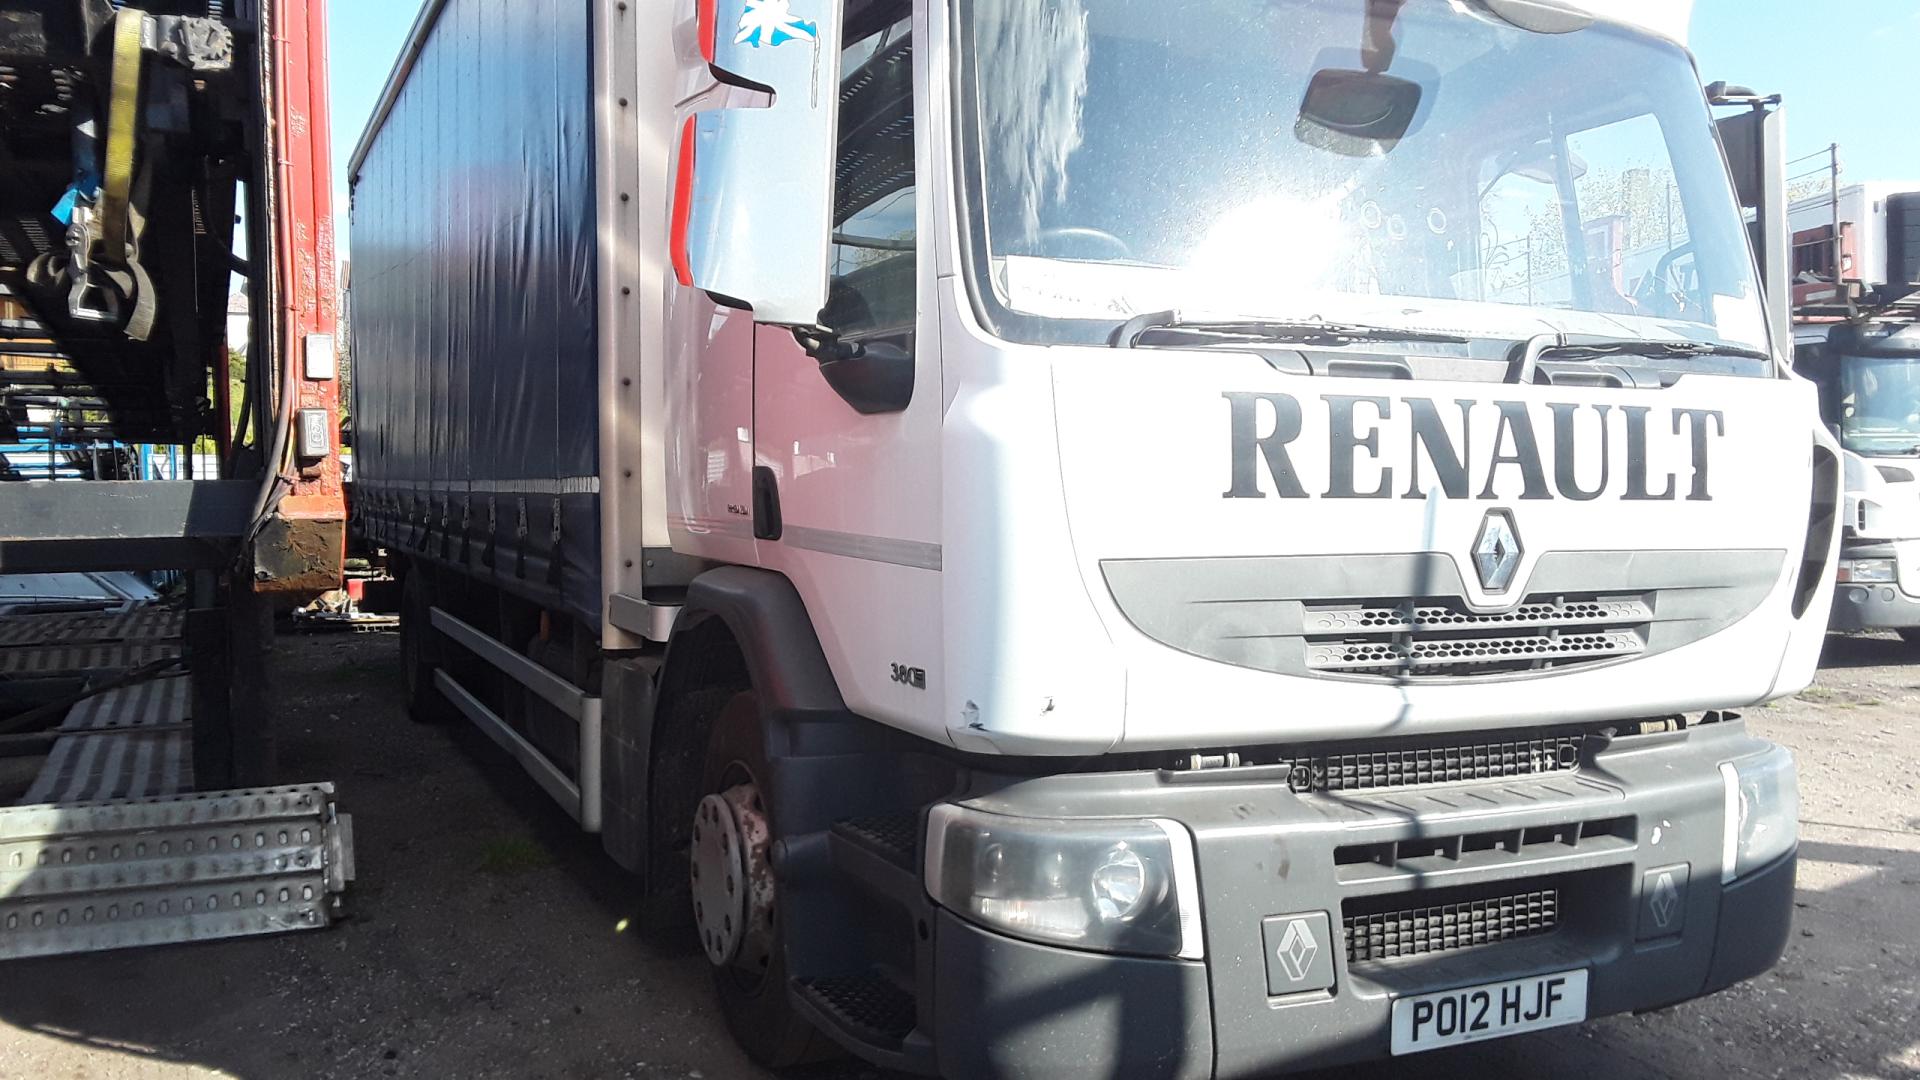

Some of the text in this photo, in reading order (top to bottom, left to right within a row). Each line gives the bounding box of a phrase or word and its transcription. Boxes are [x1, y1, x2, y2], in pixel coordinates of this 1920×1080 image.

[1222, 391, 1724, 501] RENAULT
[1412, 977, 1566, 1042] PO12 HJF
